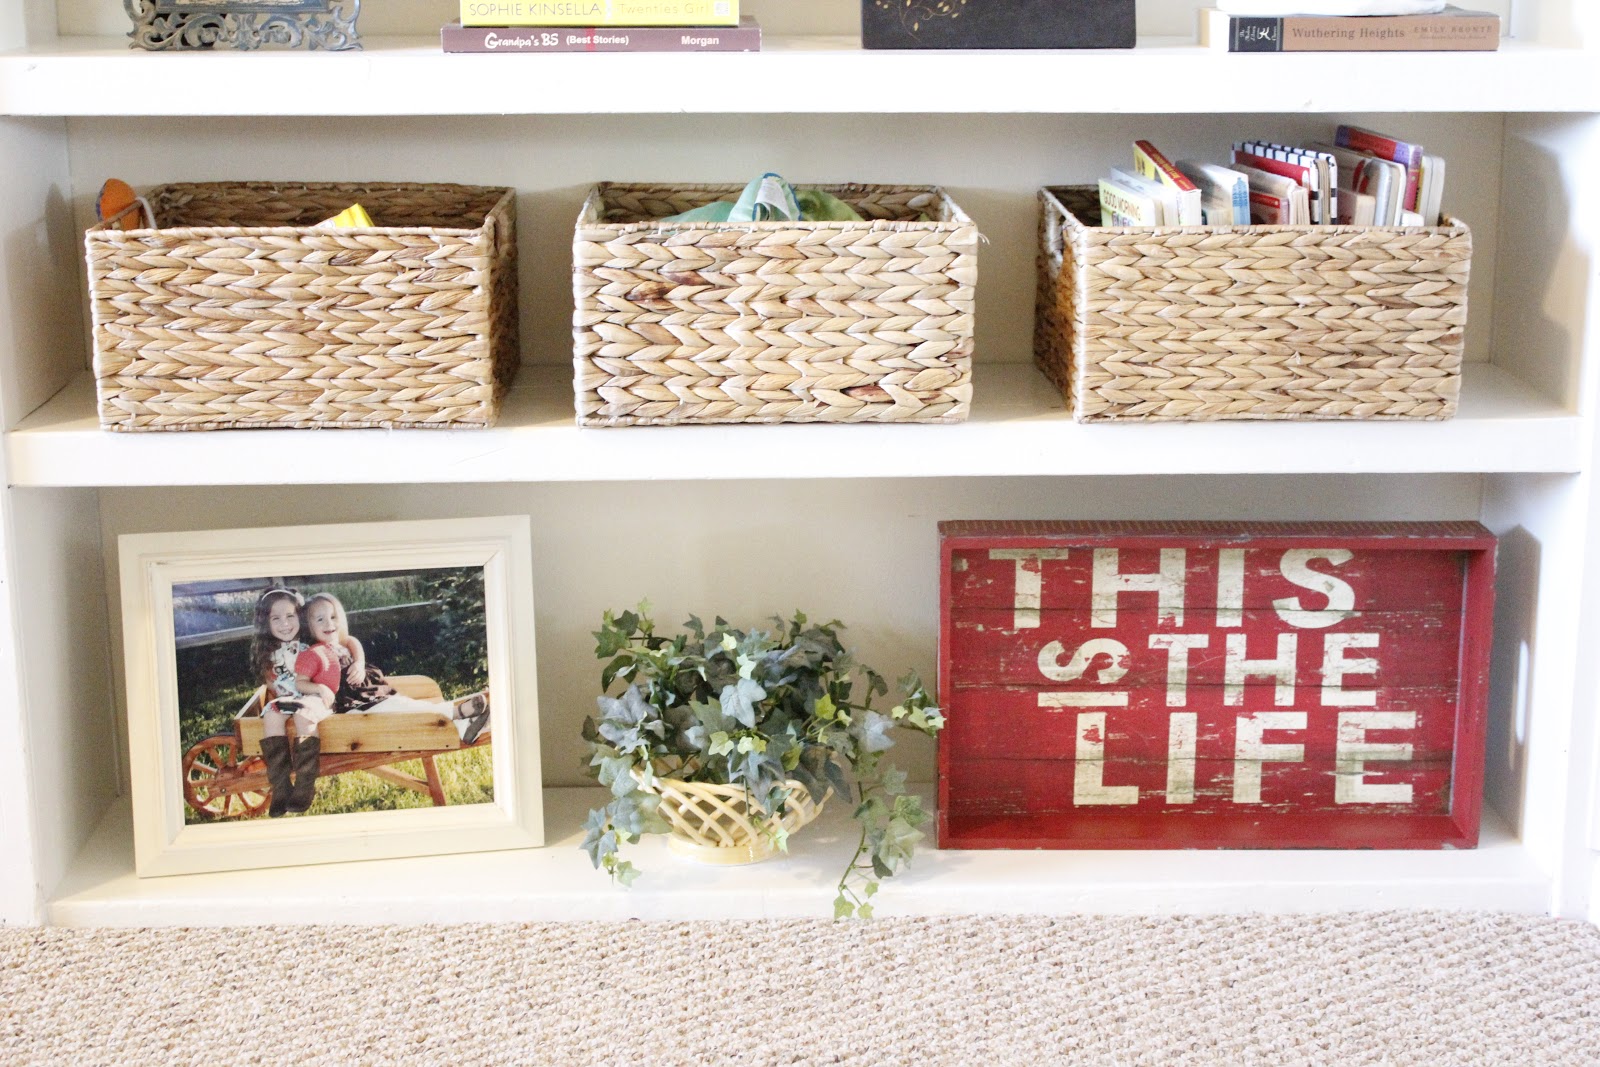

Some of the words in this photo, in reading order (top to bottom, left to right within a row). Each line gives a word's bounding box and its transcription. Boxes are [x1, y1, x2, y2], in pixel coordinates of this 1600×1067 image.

[469, 3, 523, 16] SOPHIE
[529, 3, 602, 16] KINSELLA
[619, 3, 679, 14] Twenties
[684, 2, 709, 14] Girl
[484, 32, 540, 49] Grandpa's
[540, 33, 559, 46] BS
[566, 35, 591, 46] (Best
[592, 35, 629, 46] Stories)
[681, 35, 719, 47] Morgan
[1292, 28, 1355, 40] Wuthering
[1359, 28, 1405, 40] Heights
[1103, 189, 1118, 209] GOOD
[988, 548, 1356, 629] THIS
[1148, 632, 1381, 707] THE
[1072, 711, 1418, 806] LIFE
